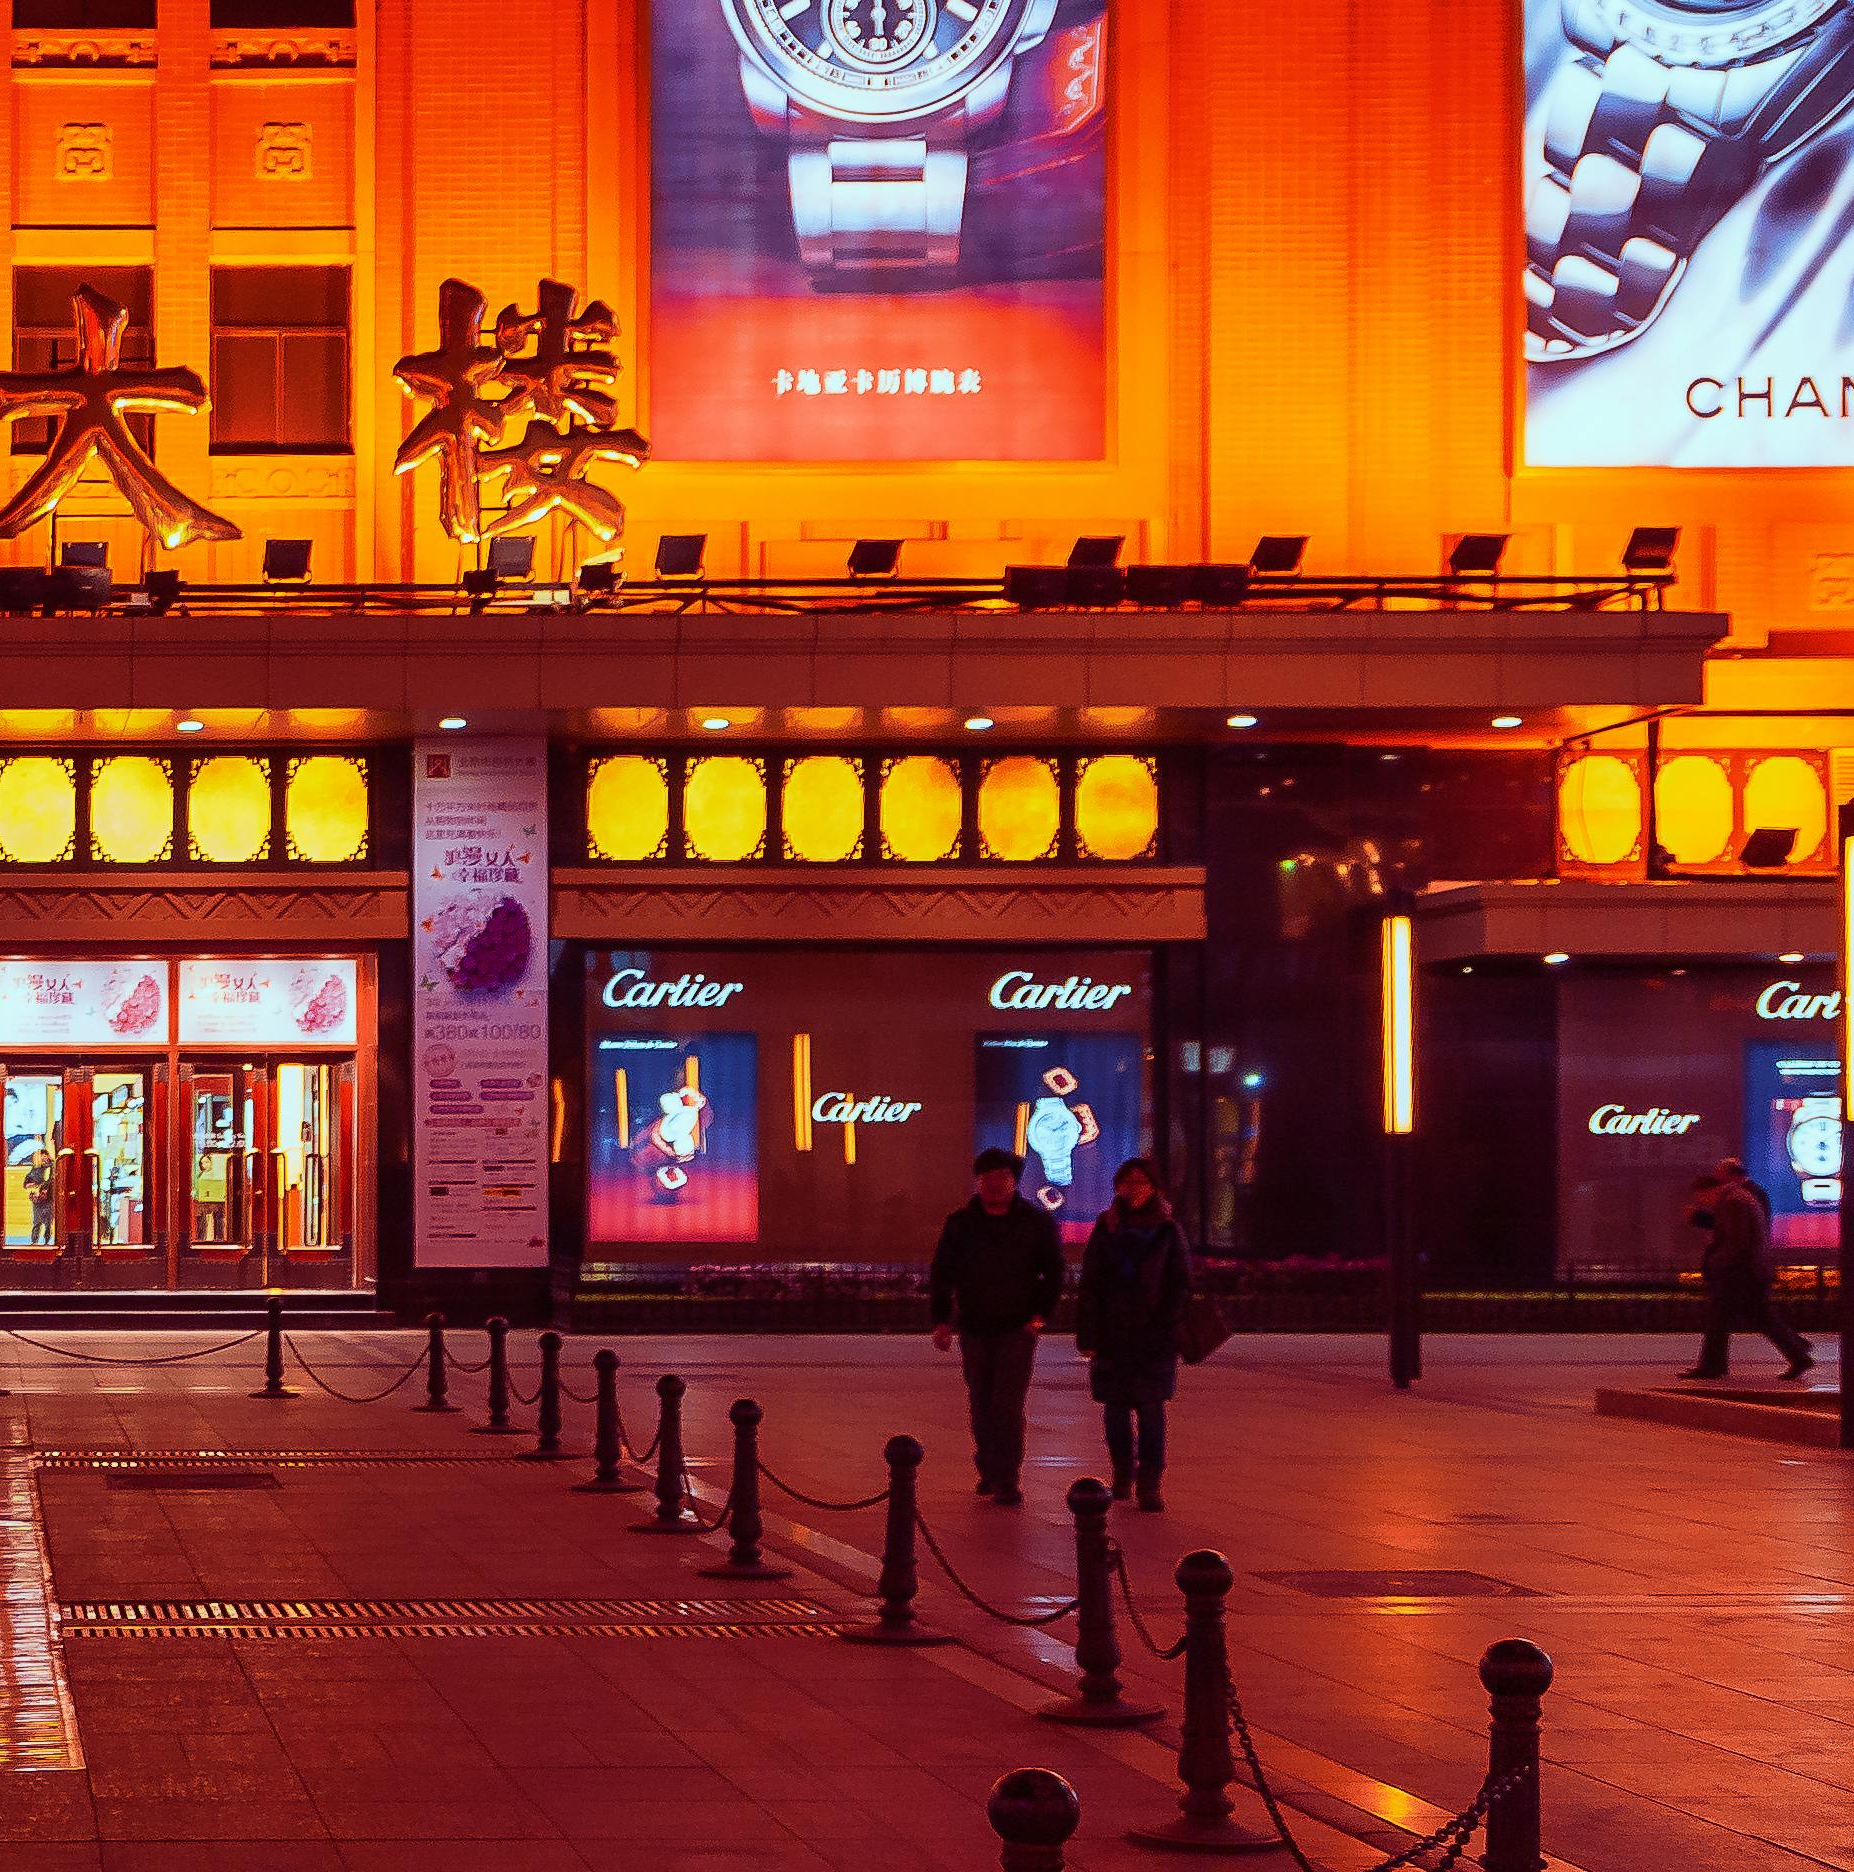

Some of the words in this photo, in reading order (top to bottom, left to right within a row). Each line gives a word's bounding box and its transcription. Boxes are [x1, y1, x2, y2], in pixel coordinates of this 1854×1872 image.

[602, 968, 744, 1008] Cartier
[989, 970, 1131, 1010] Cartier
[811, 1091, 922, 1123] Cartier
[1588, 1104, 1701, 1135] Cartier
